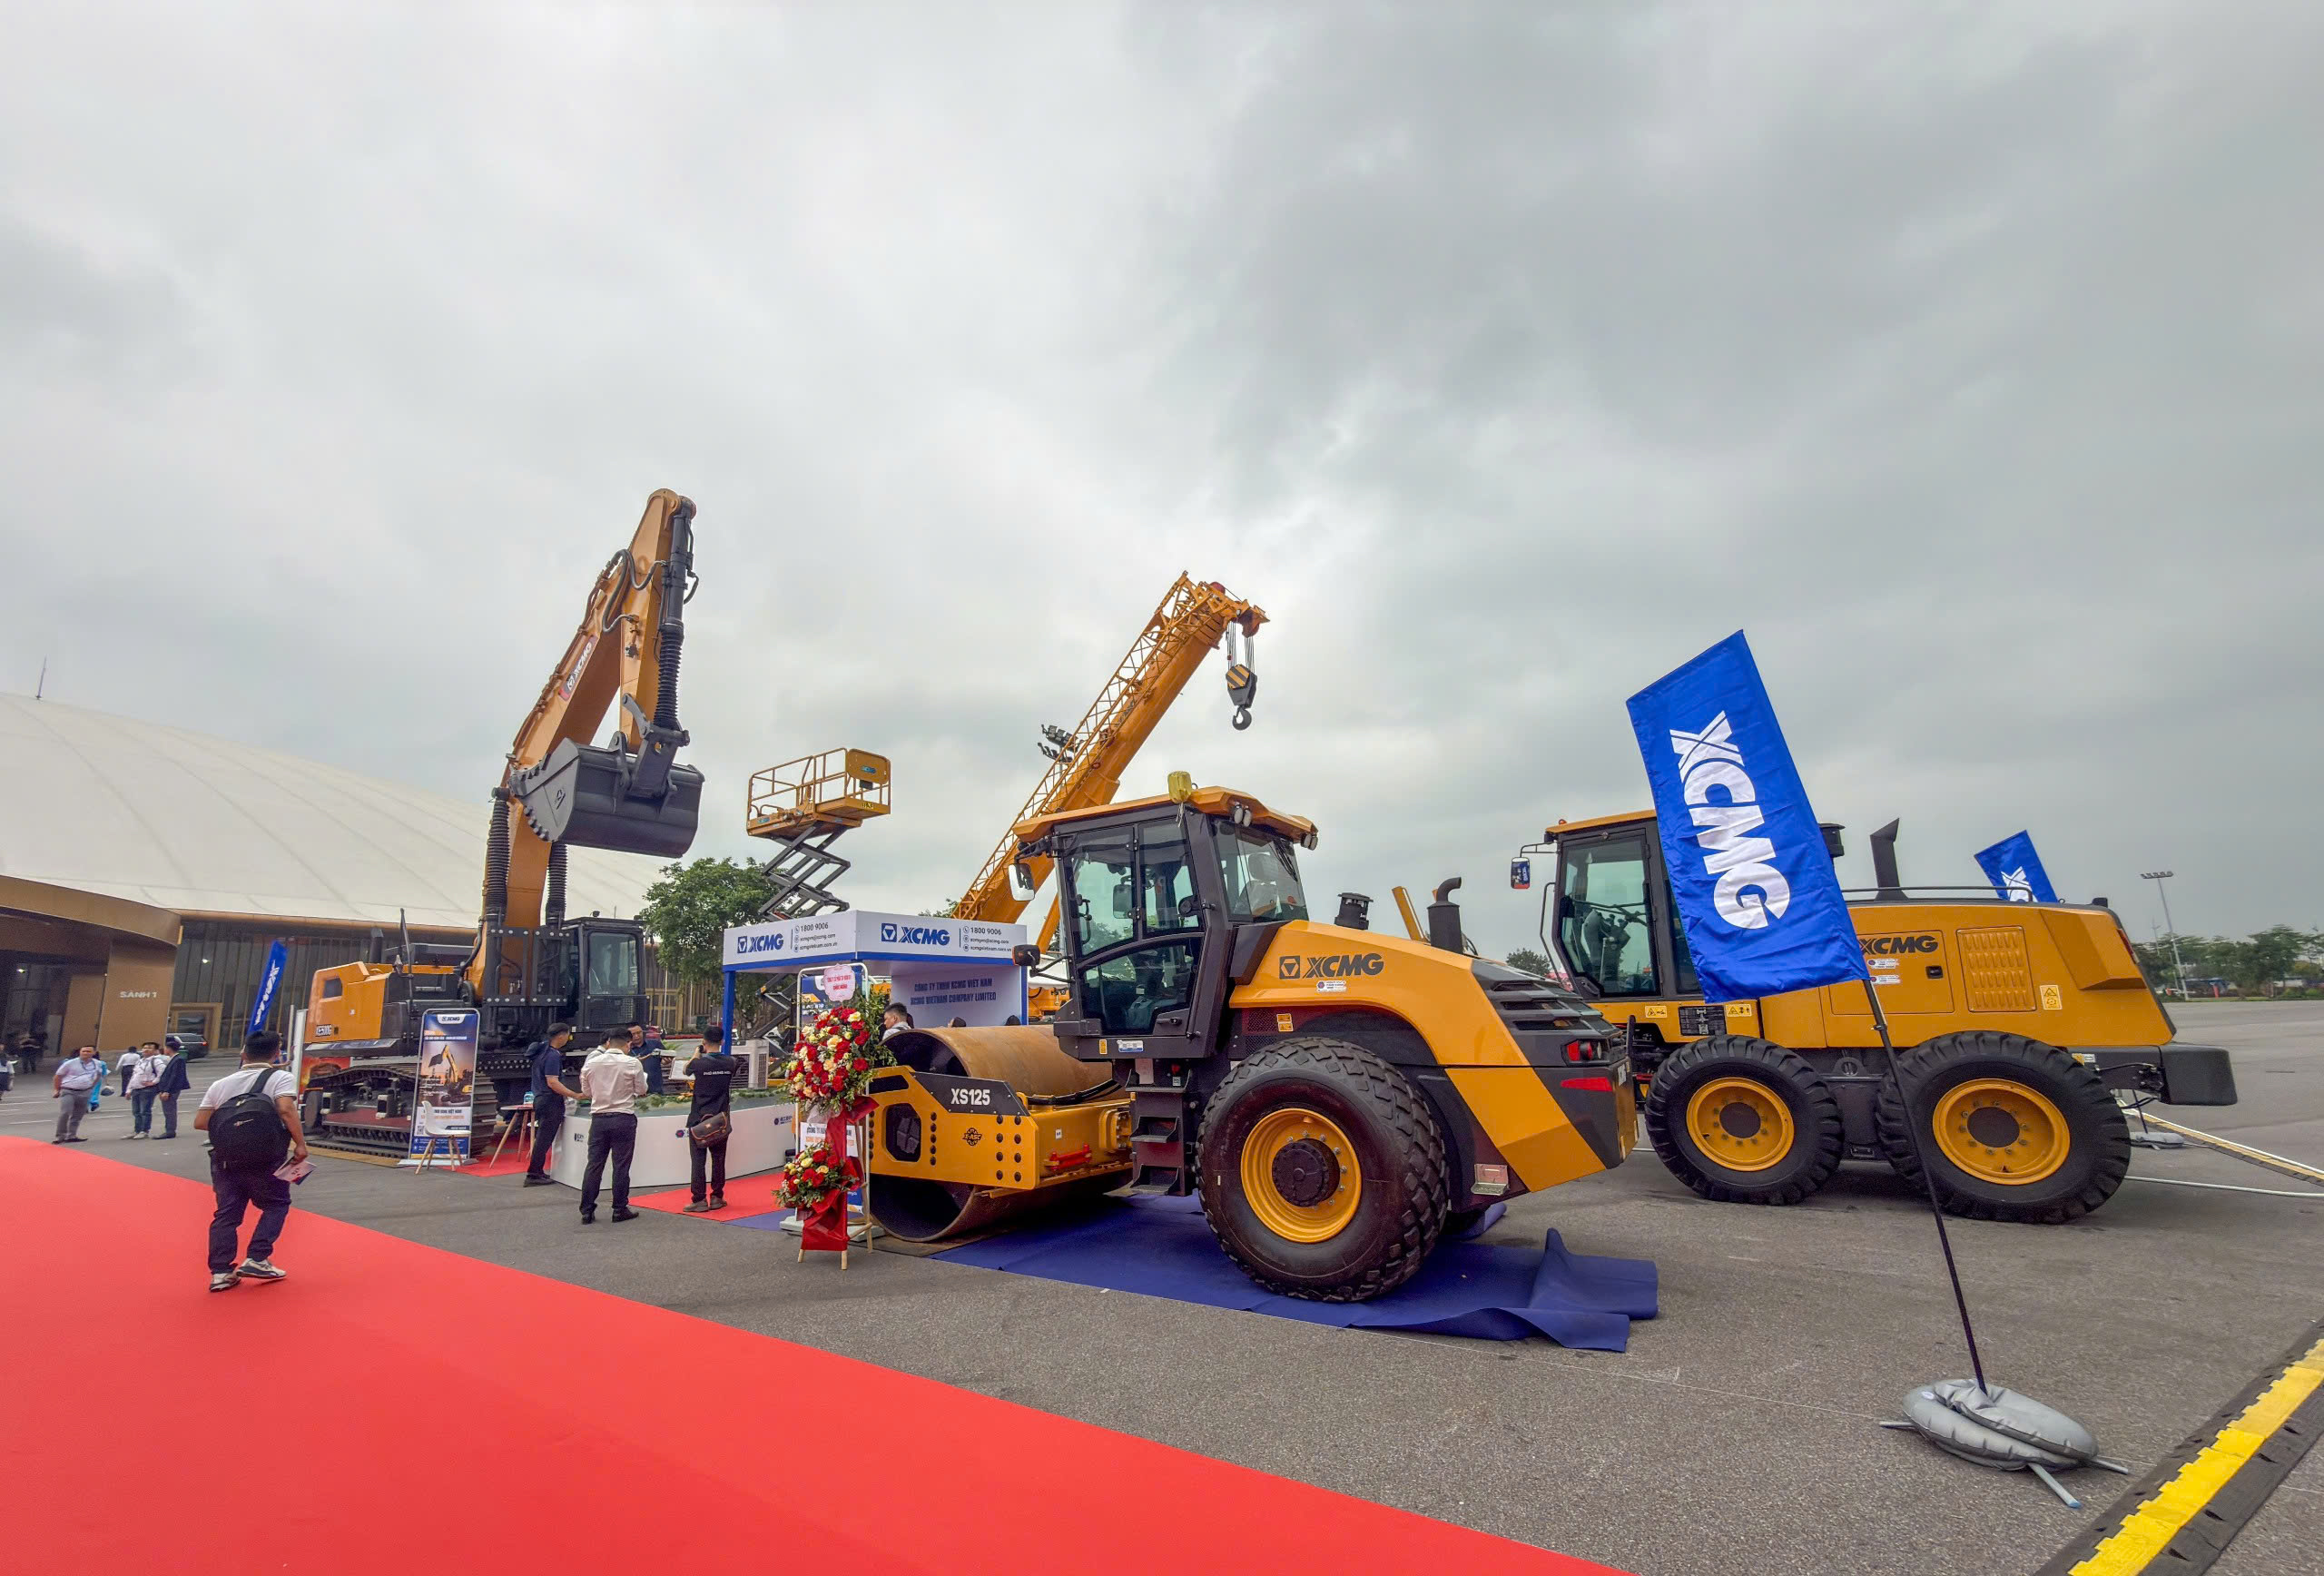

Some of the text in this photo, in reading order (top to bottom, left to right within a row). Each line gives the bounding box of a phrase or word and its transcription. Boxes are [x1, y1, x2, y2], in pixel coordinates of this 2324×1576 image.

[1669, 710, 1790, 930] XCMG
[801, 922, 829, 932] 1800 9006
[898, 926, 950, 946] XCMG
[748, 933, 784, 953] XCMG
[1858, 935, 1938, 955] XCMG
[1303, 953, 1384, 979] XCMG
[949, 993, 974, 1003] COMPANY
[975, 991, 997, 1001] LIMITED
[950, 1088, 990, 1106] XS125
